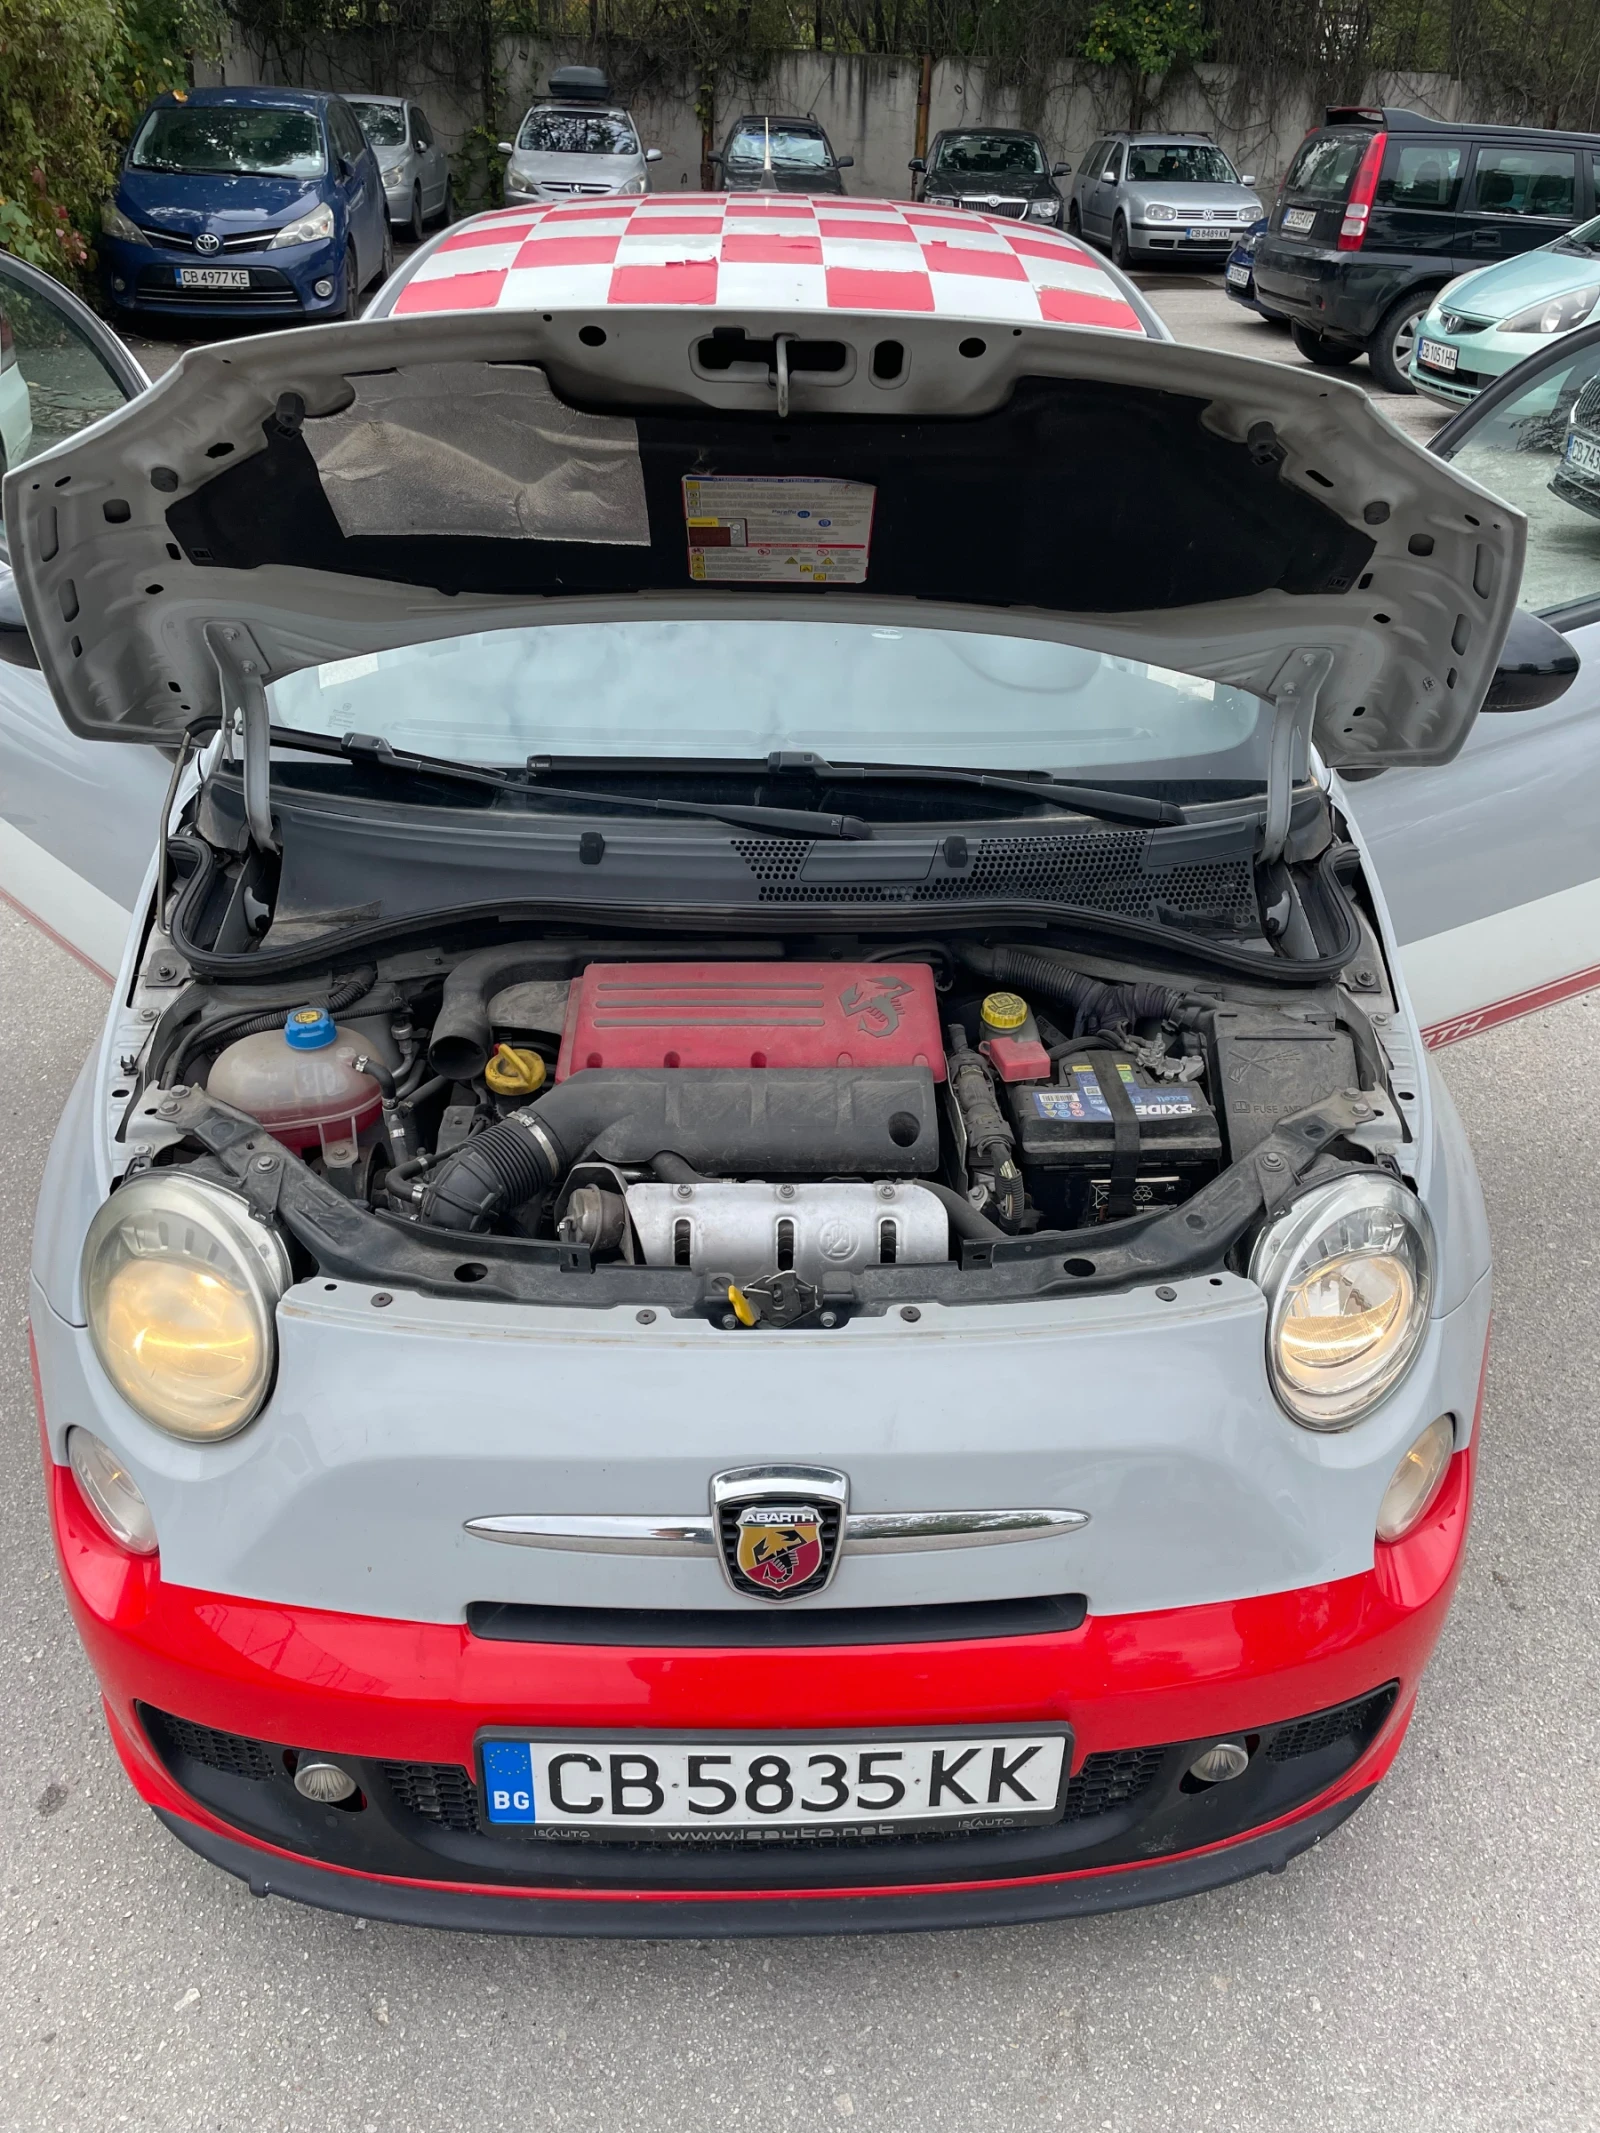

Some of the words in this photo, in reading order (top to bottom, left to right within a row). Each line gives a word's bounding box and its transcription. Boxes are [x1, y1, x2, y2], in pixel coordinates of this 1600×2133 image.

[1190, 230, 1200, 238] CB
[182, 270, 199, 283] CB
[200, 271, 229, 284] 4977
[230, 272, 248, 285] KE
[1422, 341, 1430, 358] CB
[1430, 344, 1444, 363] 1051
[1443, 348, 1457, 368] HH
[1572, 439, 1583, 462] CB
[1582, 444, 1600, 470] 743
[1155, 1095, 1190, 1103] Excell
[1135, 1104, 1194, 1115] EXIDE
[1253, 1105, 1279, 1114] FUSE
[744, 1512, 814, 1523] ABARTH
[547, 1752, 665, 1815] CB
[687, 1750, 906, 1815] 5835
[928, 1745, 1044, 1807] KK
[493, 1790, 530, 1810] BG
[667, 1823, 895, 1841] www.isauto.net
